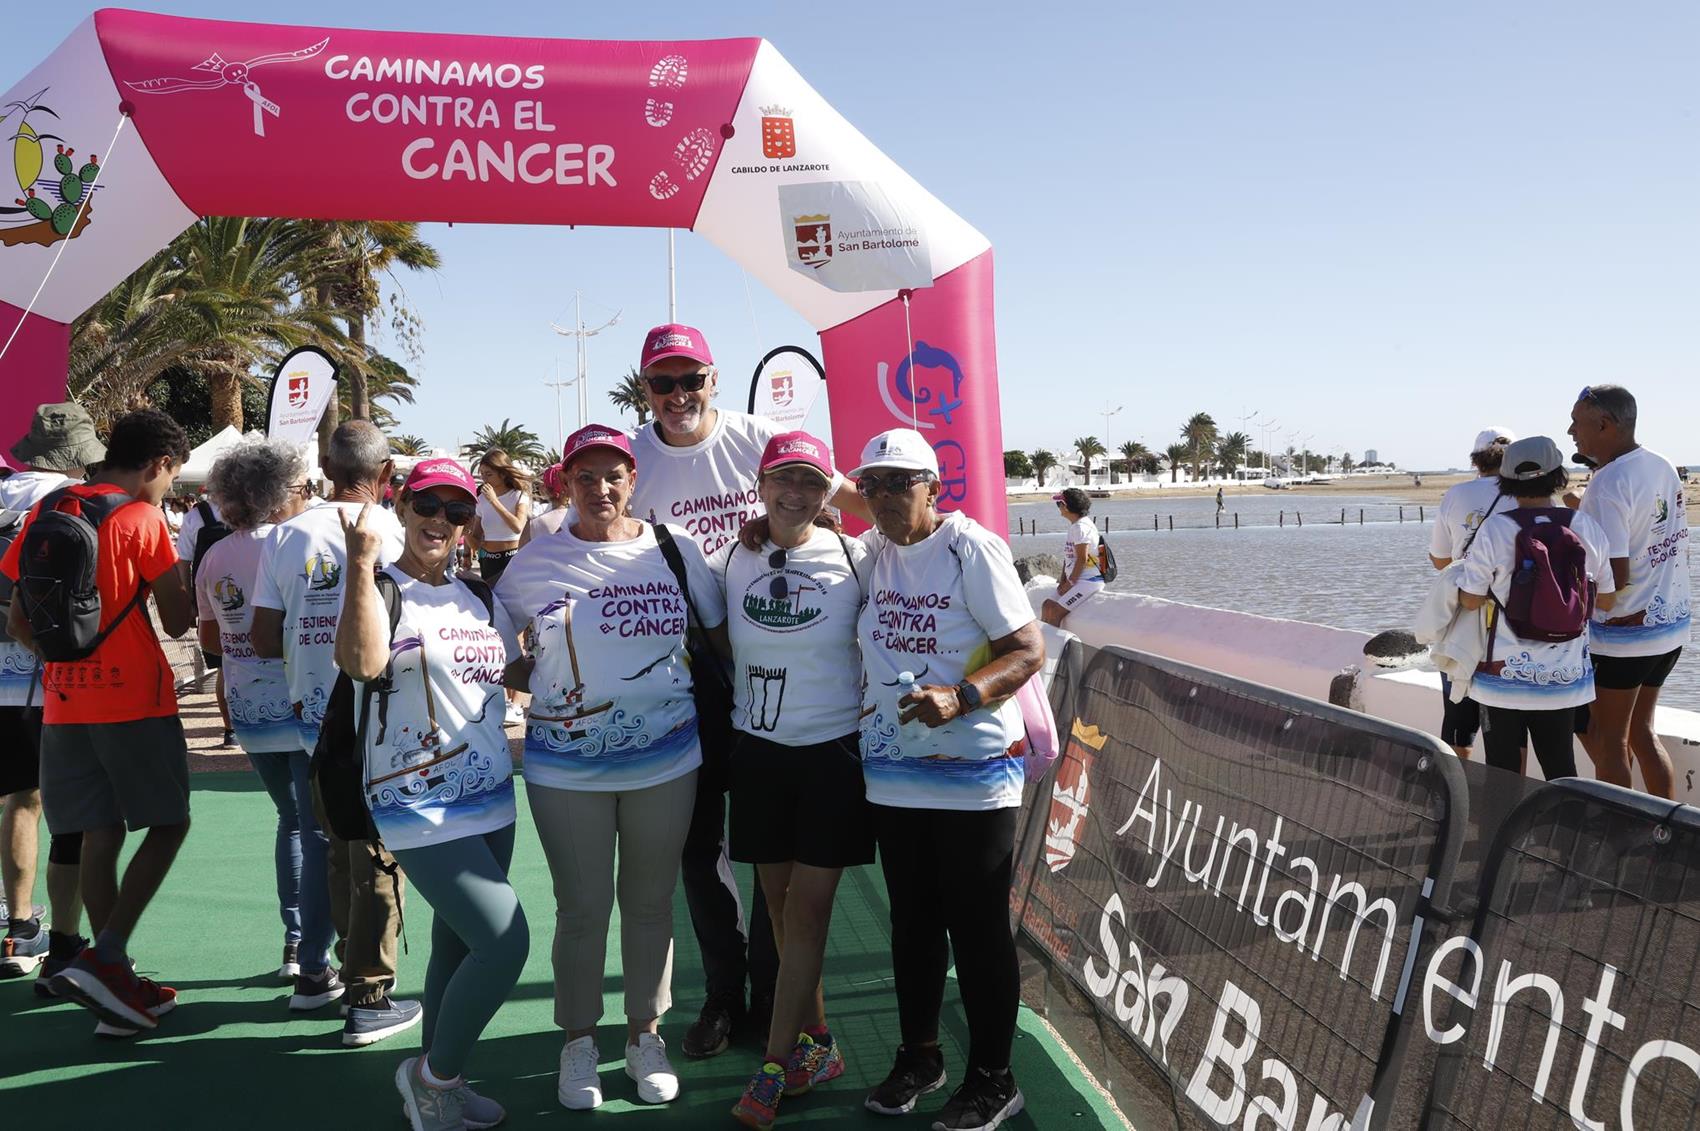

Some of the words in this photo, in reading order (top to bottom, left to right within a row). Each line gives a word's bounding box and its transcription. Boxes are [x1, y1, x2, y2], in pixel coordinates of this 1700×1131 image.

[325, 55, 545, 90] CAMINAMOS
[346, 92, 501, 129] CONTRA
[514, 100, 556, 132] EL
[402, 137, 618, 187] CANCER
[731, 165, 768, 174] CABILDO
[770, 165, 780, 173] DE
[782, 163, 830, 172] LANZAROTE
[837, 227, 904, 241] Ayuntamiento
[838, 242, 859, 252] San
[671, 489, 763, 517] CAMINAMO
[588, 582, 683, 599] CAMINAMO
[601, 598, 684, 618] CONTRA
[876, 589, 951, 611] CAMINAMOS
[600, 622, 616, 635] EL
[760, 615, 800, 625] LANZAROTE
[878, 610, 937, 633] CONTRA
[299, 633, 310, 646] DE
[872, 629, 885, 641] EL
[1083, 892, 1189, 1067] San
